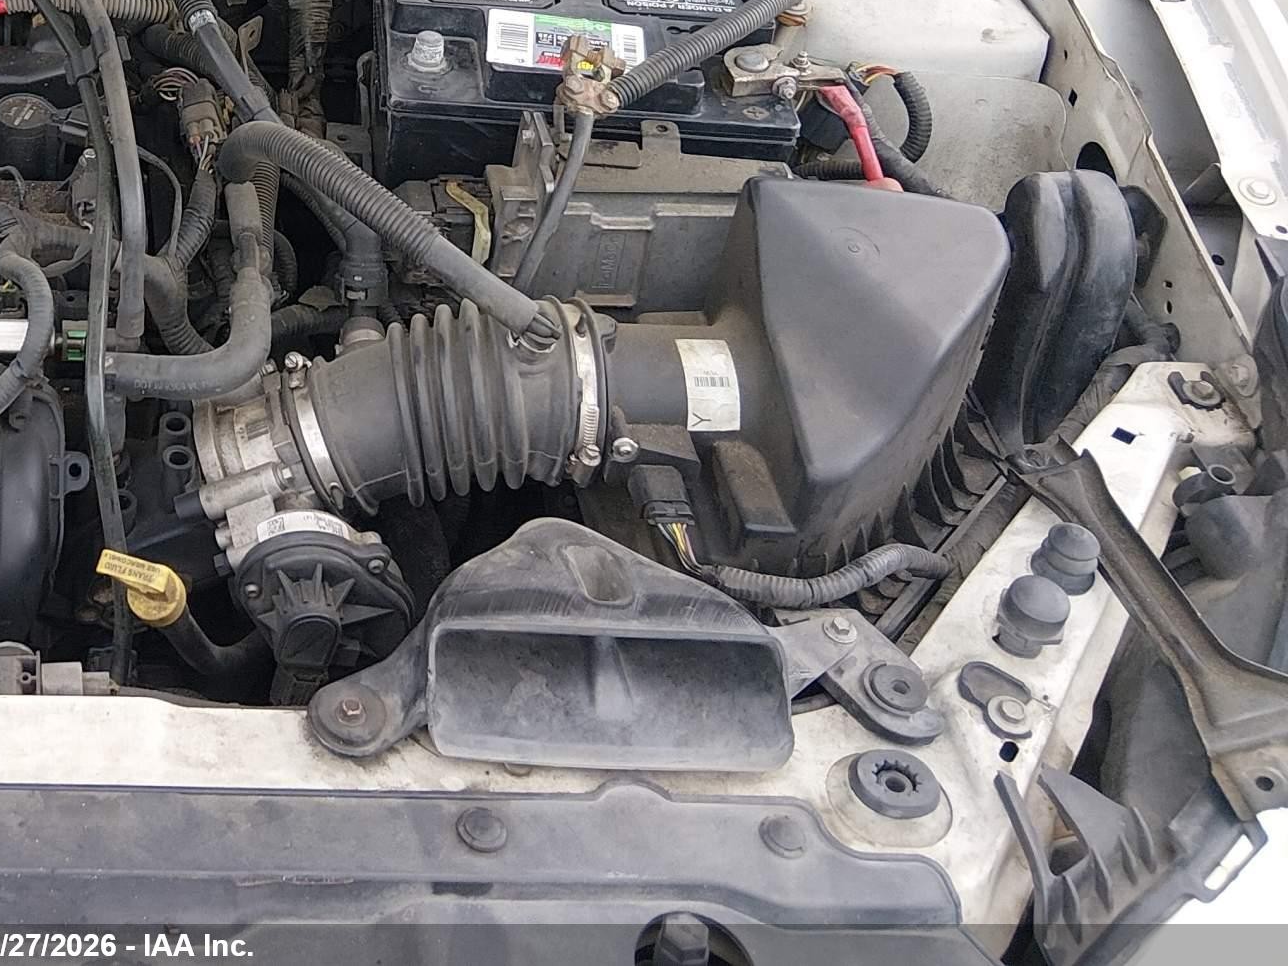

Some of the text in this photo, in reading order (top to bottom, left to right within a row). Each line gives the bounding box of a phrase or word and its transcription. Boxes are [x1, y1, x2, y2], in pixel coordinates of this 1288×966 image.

[626, 0, 667, 10] POISON
[677, 5, 722, 13] DANGER
[104, 562, 153, 582] TRANS FLUID
